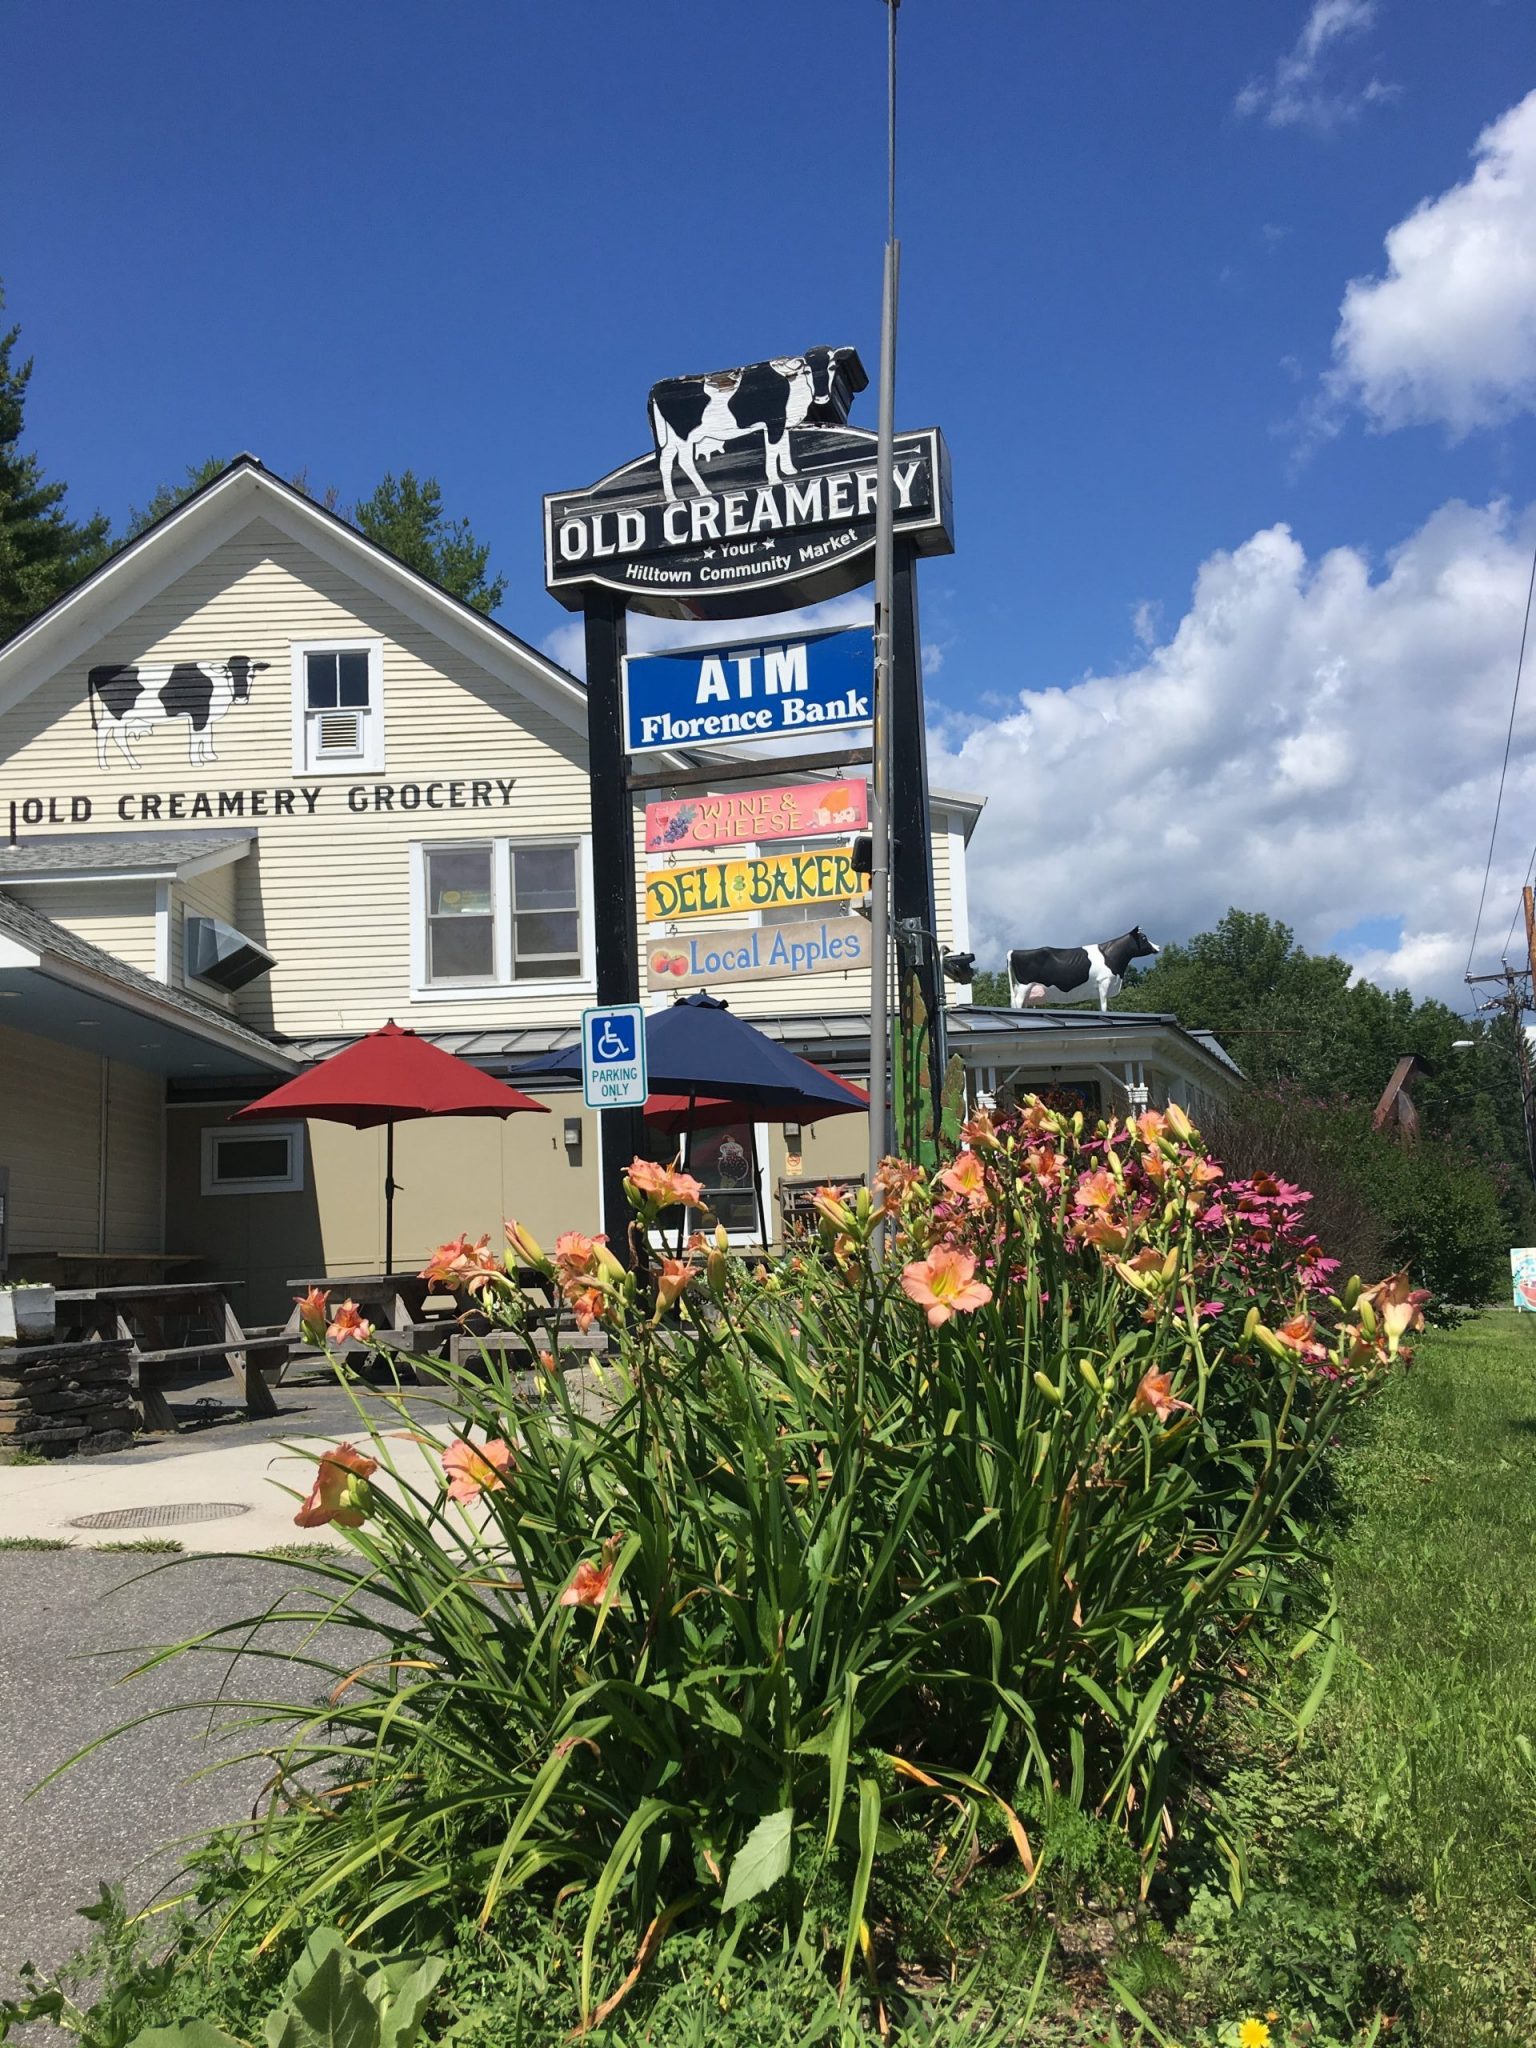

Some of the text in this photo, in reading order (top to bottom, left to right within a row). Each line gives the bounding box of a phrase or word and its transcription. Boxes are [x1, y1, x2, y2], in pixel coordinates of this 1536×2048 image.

[559, 461, 920, 561] OLD CREAMERY
[625, 528, 858, 583] Hilltown Community Market
[720, 540, 758, 556] Your
[695, 642, 809, 704] ATM
[641, 689, 868, 743] Florence Bank
[21, 778, 518, 824] OLD CREAMERY GROCERY
[699, 792, 798, 820] WINE &
[692, 813, 805, 841] CHEESE
[647, 864, 730, 917] DELI
[689, 924, 861, 976] Local Apples
[592, 1067, 638, 1082] PARKING
[601, 1083, 629, 1097] ONLY
